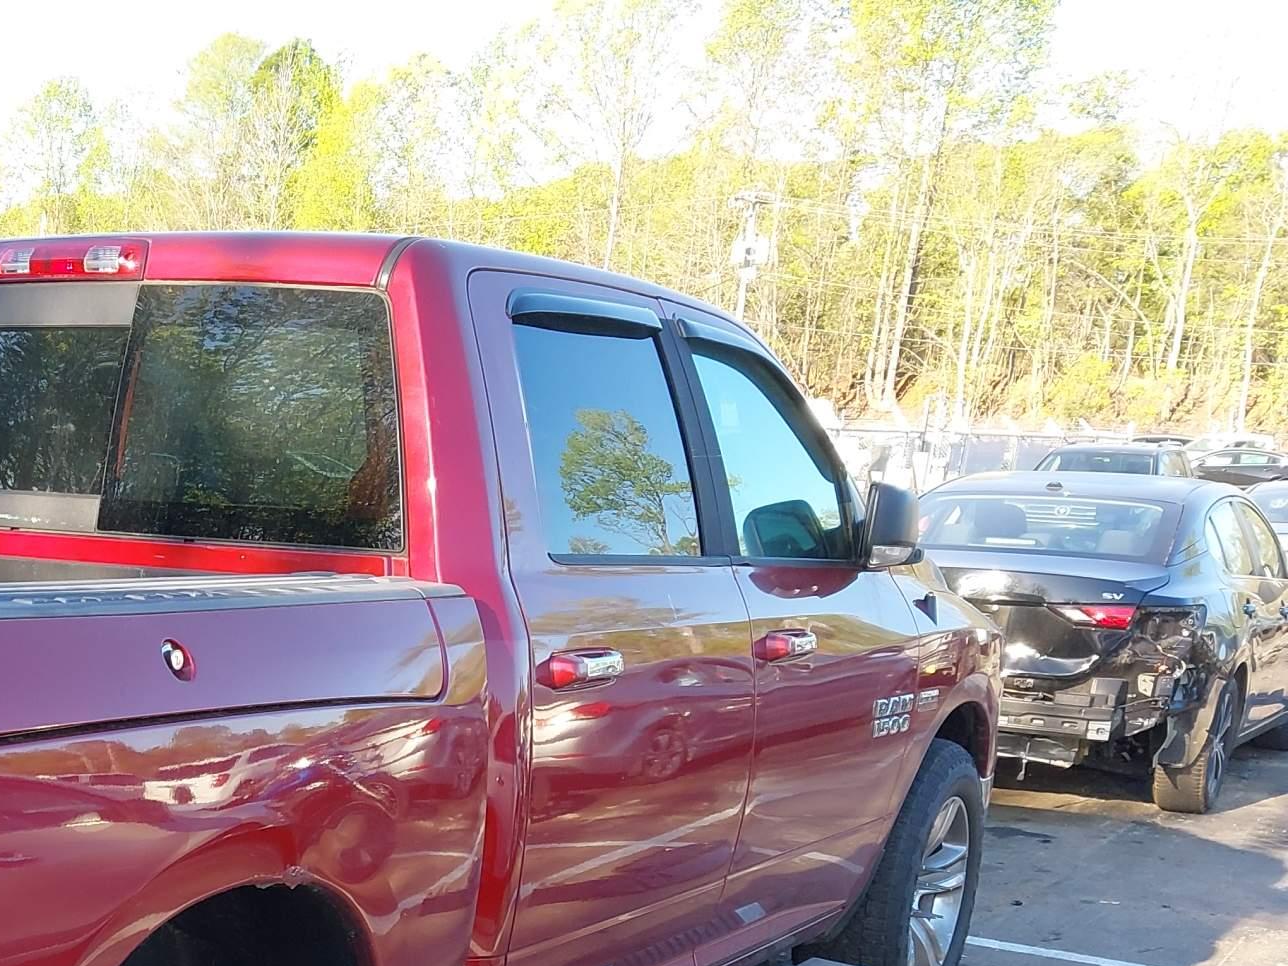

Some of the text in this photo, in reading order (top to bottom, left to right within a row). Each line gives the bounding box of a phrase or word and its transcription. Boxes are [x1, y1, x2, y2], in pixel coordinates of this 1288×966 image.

[1102, 592, 1125, 601] SV
[873, 694, 914, 718] RAM
[873, 714, 911, 738] 1500
